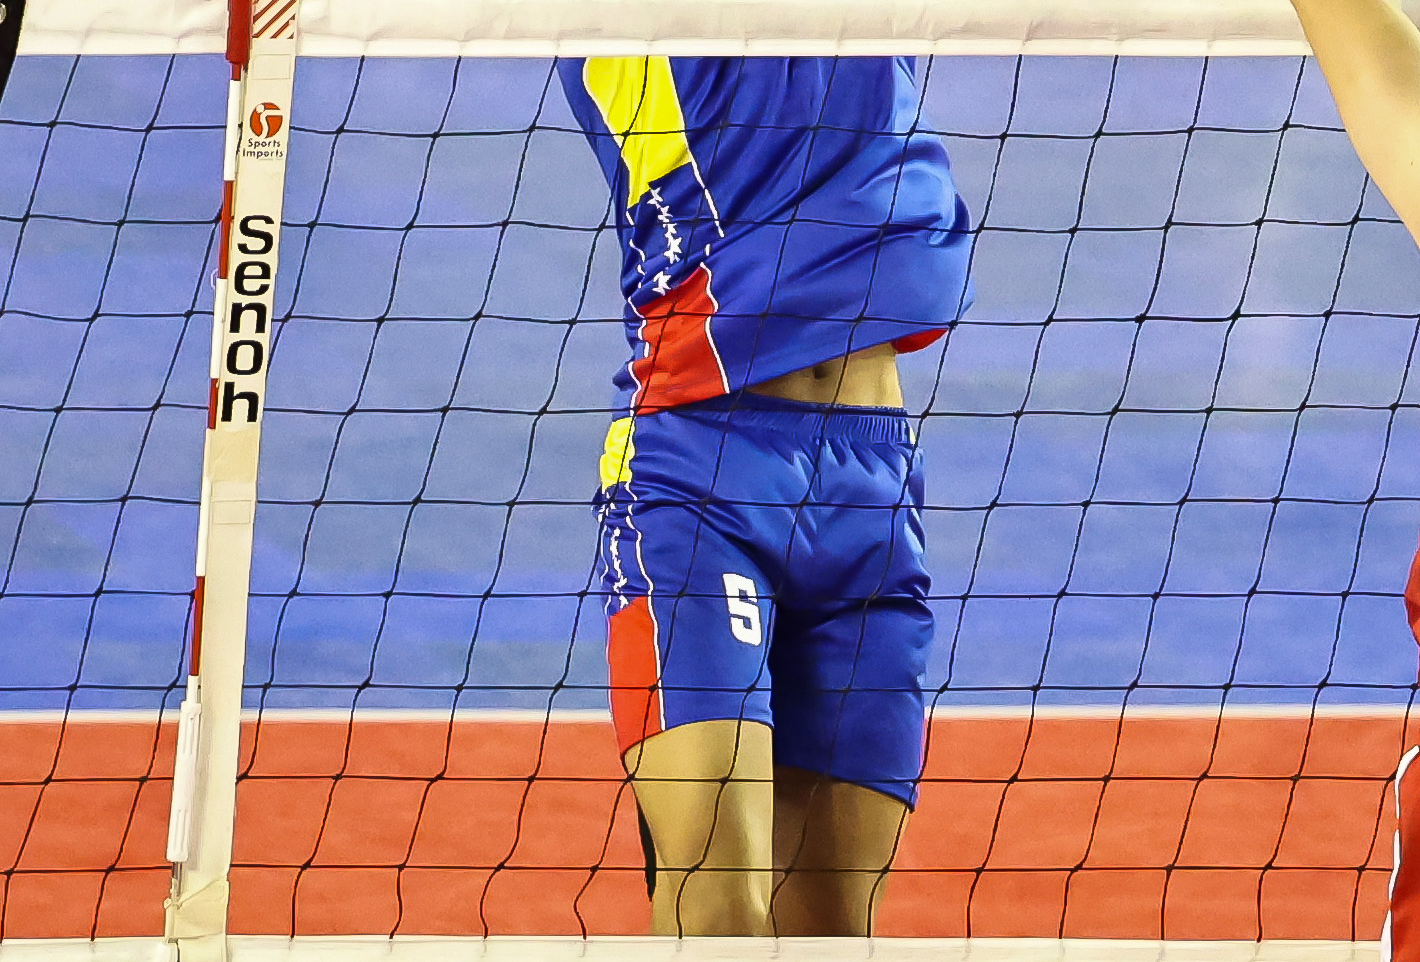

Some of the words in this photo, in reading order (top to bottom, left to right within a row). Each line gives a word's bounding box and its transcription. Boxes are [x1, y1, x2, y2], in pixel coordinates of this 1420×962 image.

[242, 148, 284, 160] Imports
[248, 138, 281, 150] Sports
[220, 214, 276, 424] Senoh
[721, 571, 763, 647] 5
